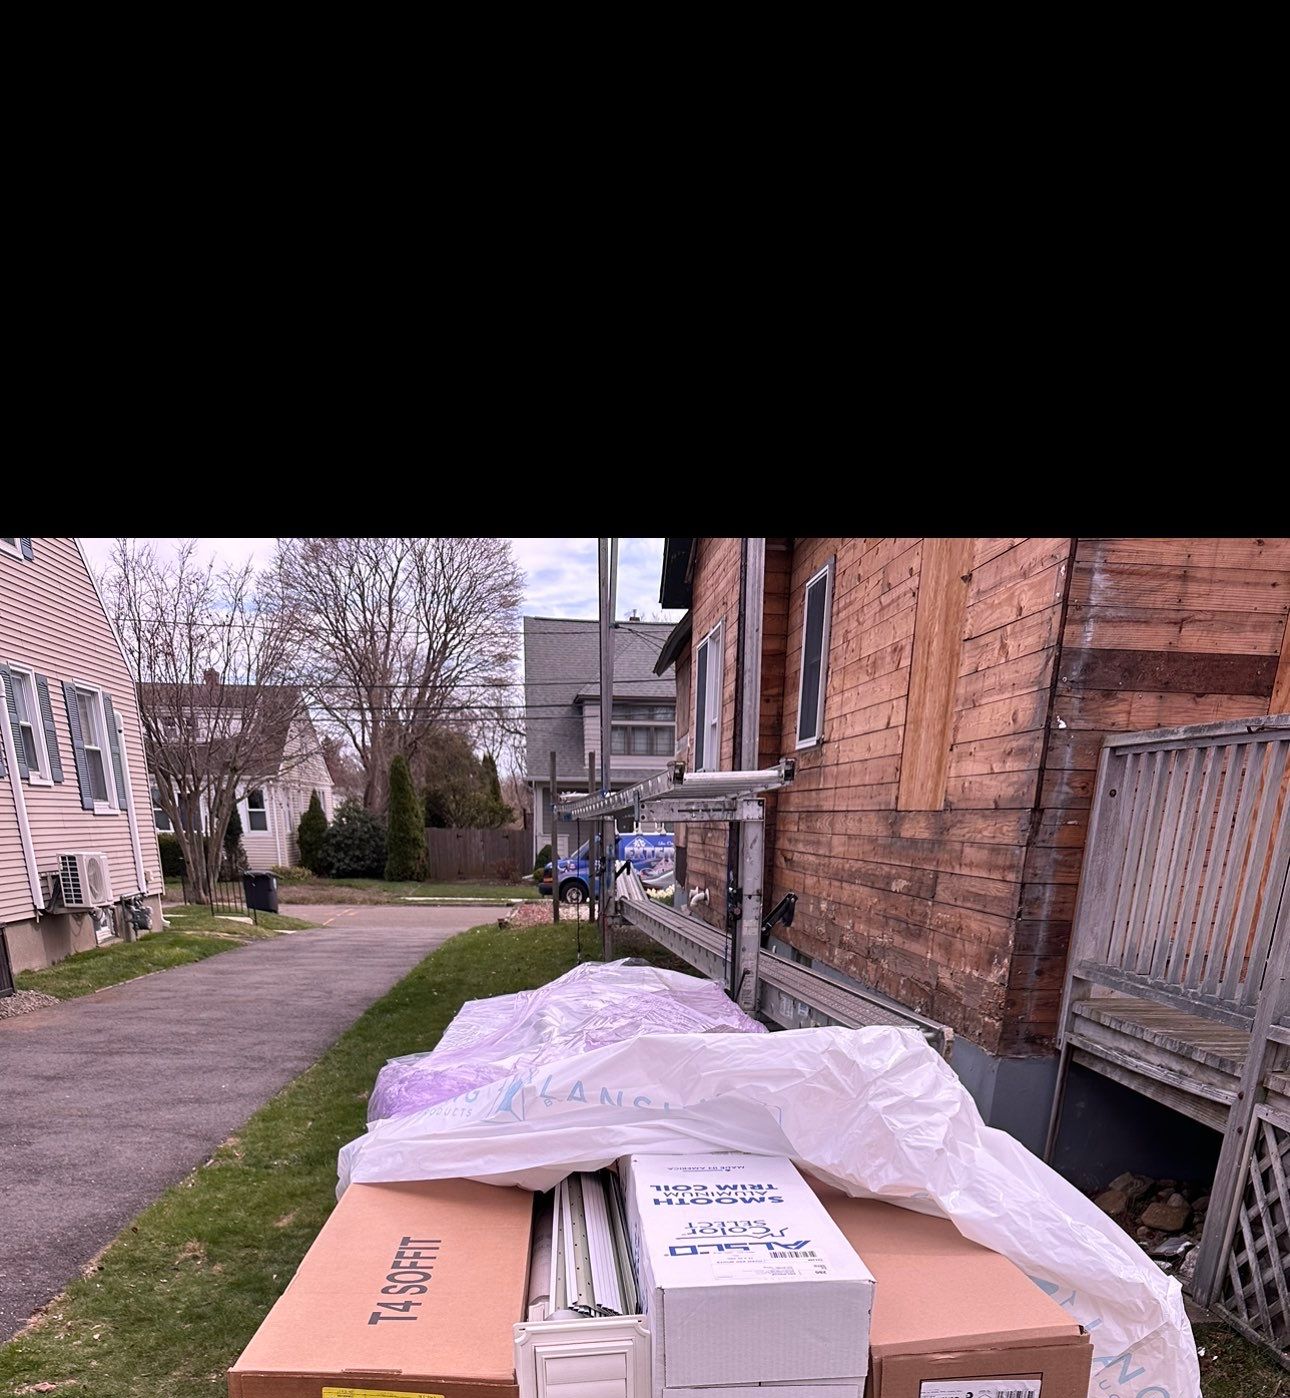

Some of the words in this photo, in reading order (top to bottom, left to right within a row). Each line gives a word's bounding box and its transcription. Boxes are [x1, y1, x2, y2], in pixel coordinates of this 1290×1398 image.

[650, 1184, 708, 1192] COIL
[653, 1196, 785, 1206] SMOOTH
[685, 1220, 767, 1229] SELECT
[689, 1226, 771, 1237] Color
[668, 1241, 812, 1257] ALSCO
[380, 1236, 442, 1295] SOFFIT
[368, 1301, 422, 1325] T4
